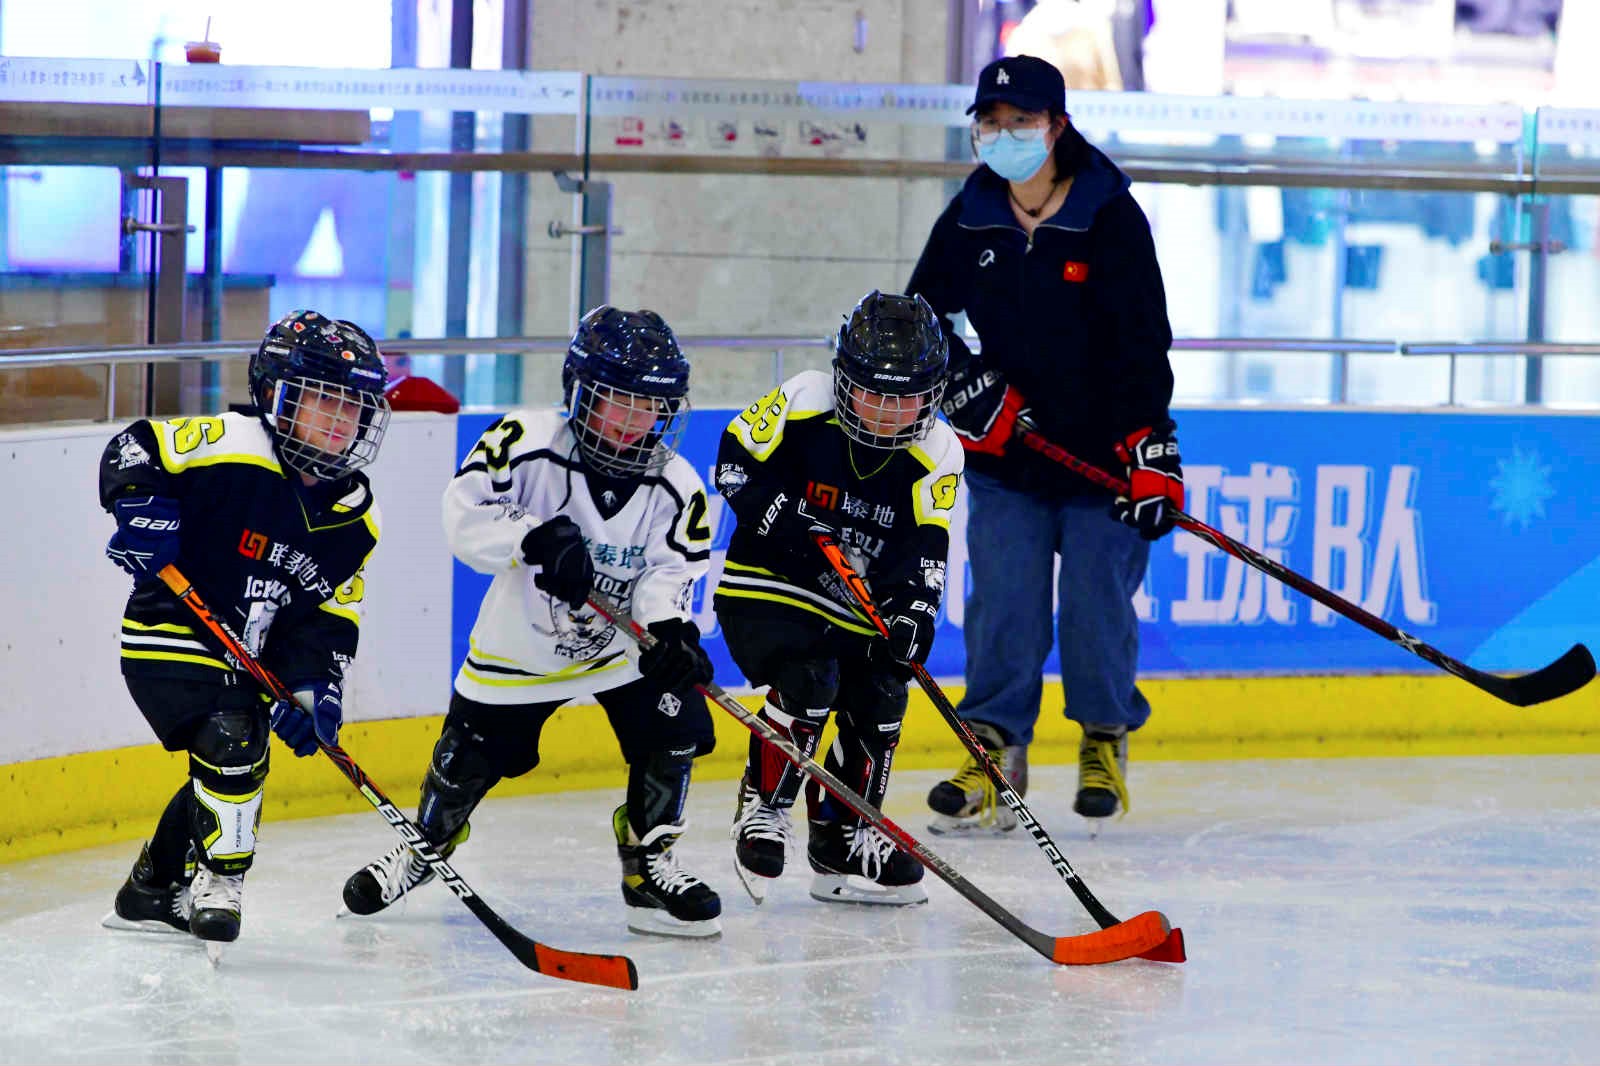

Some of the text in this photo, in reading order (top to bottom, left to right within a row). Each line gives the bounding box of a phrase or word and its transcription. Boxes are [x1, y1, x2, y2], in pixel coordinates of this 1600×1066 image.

[943, 370, 999, 415] BAUE
[757, 491, 789, 537] UER
[1118, 461, 1437, 627] 球队
